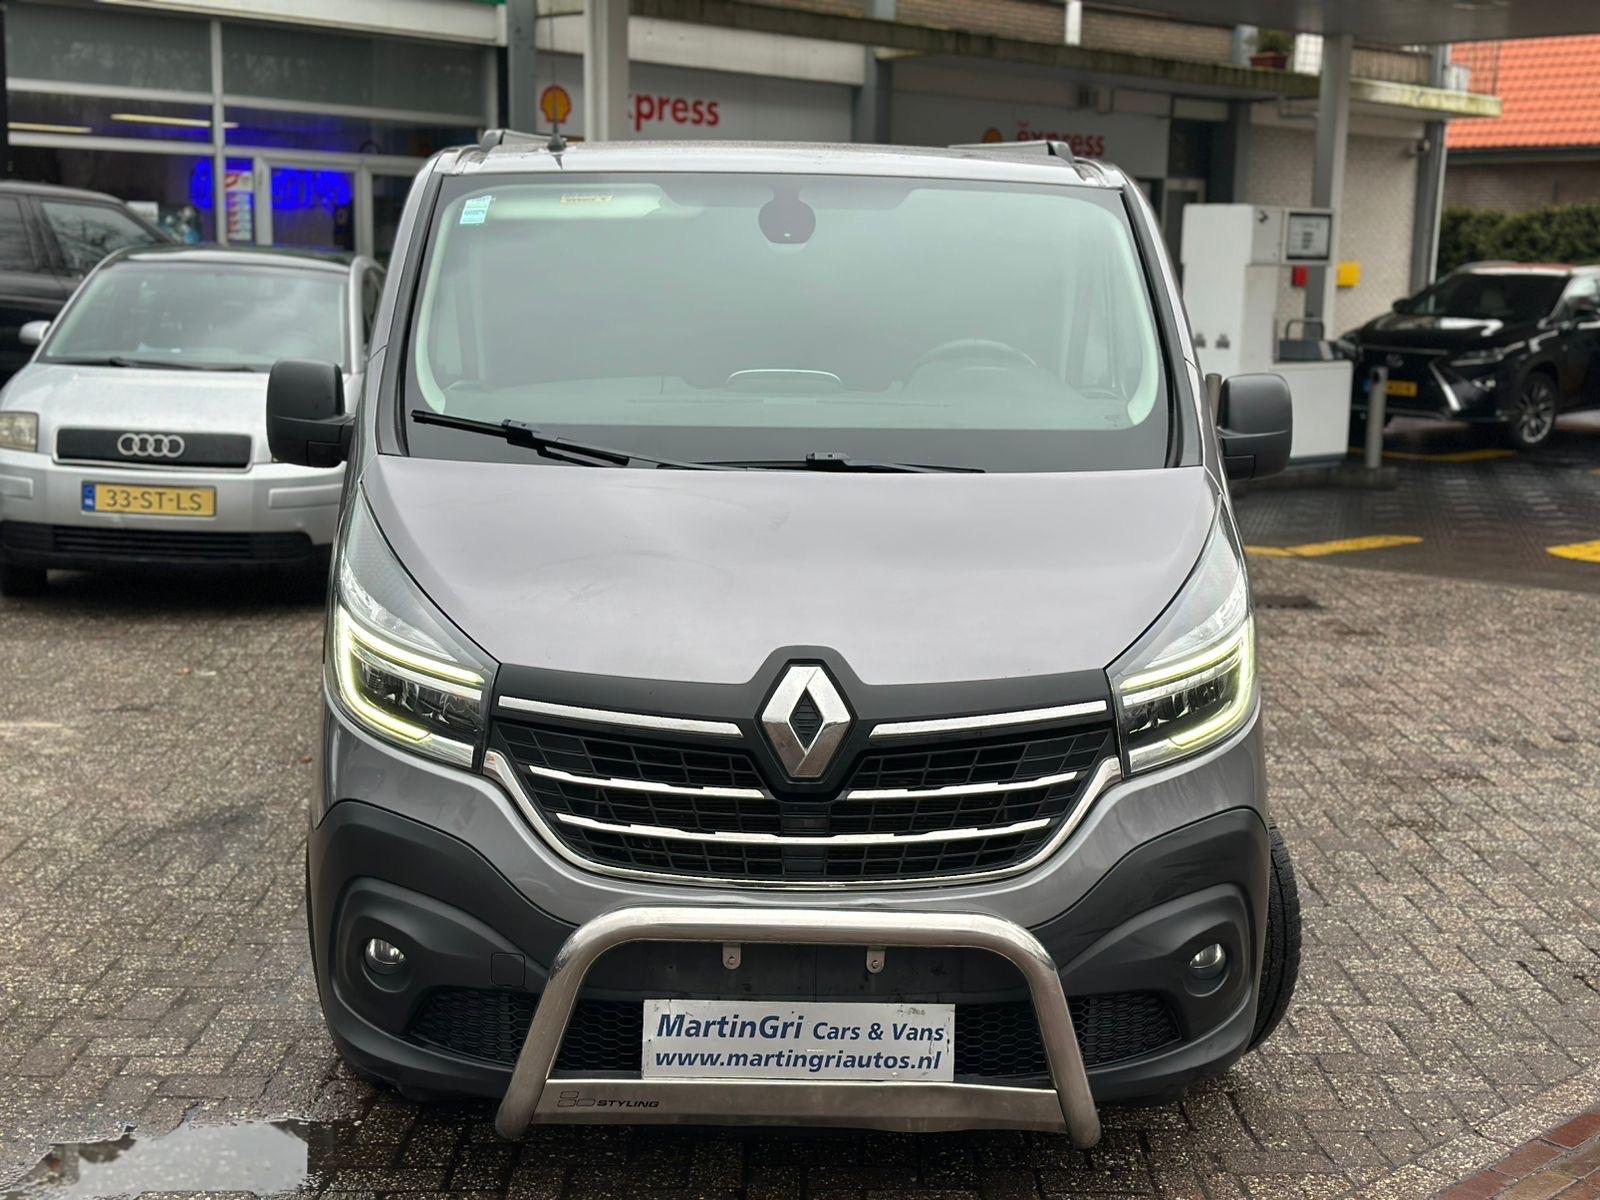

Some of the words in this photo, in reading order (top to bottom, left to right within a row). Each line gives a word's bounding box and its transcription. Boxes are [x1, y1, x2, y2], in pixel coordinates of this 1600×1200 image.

[628, 93, 720, 133] press
[106, 489, 202, 511] 33-ST-LS
[656, 1014, 804, 1039] MartinGri
[812, 1022, 860, 1041] Cars
[867, 1023, 883, 1041] &
[892, 1024, 945, 1042] Vans
[655, 1050, 942, 1072] www.martingriautos.nl
[597, 1100, 660, 1108] STYLING
